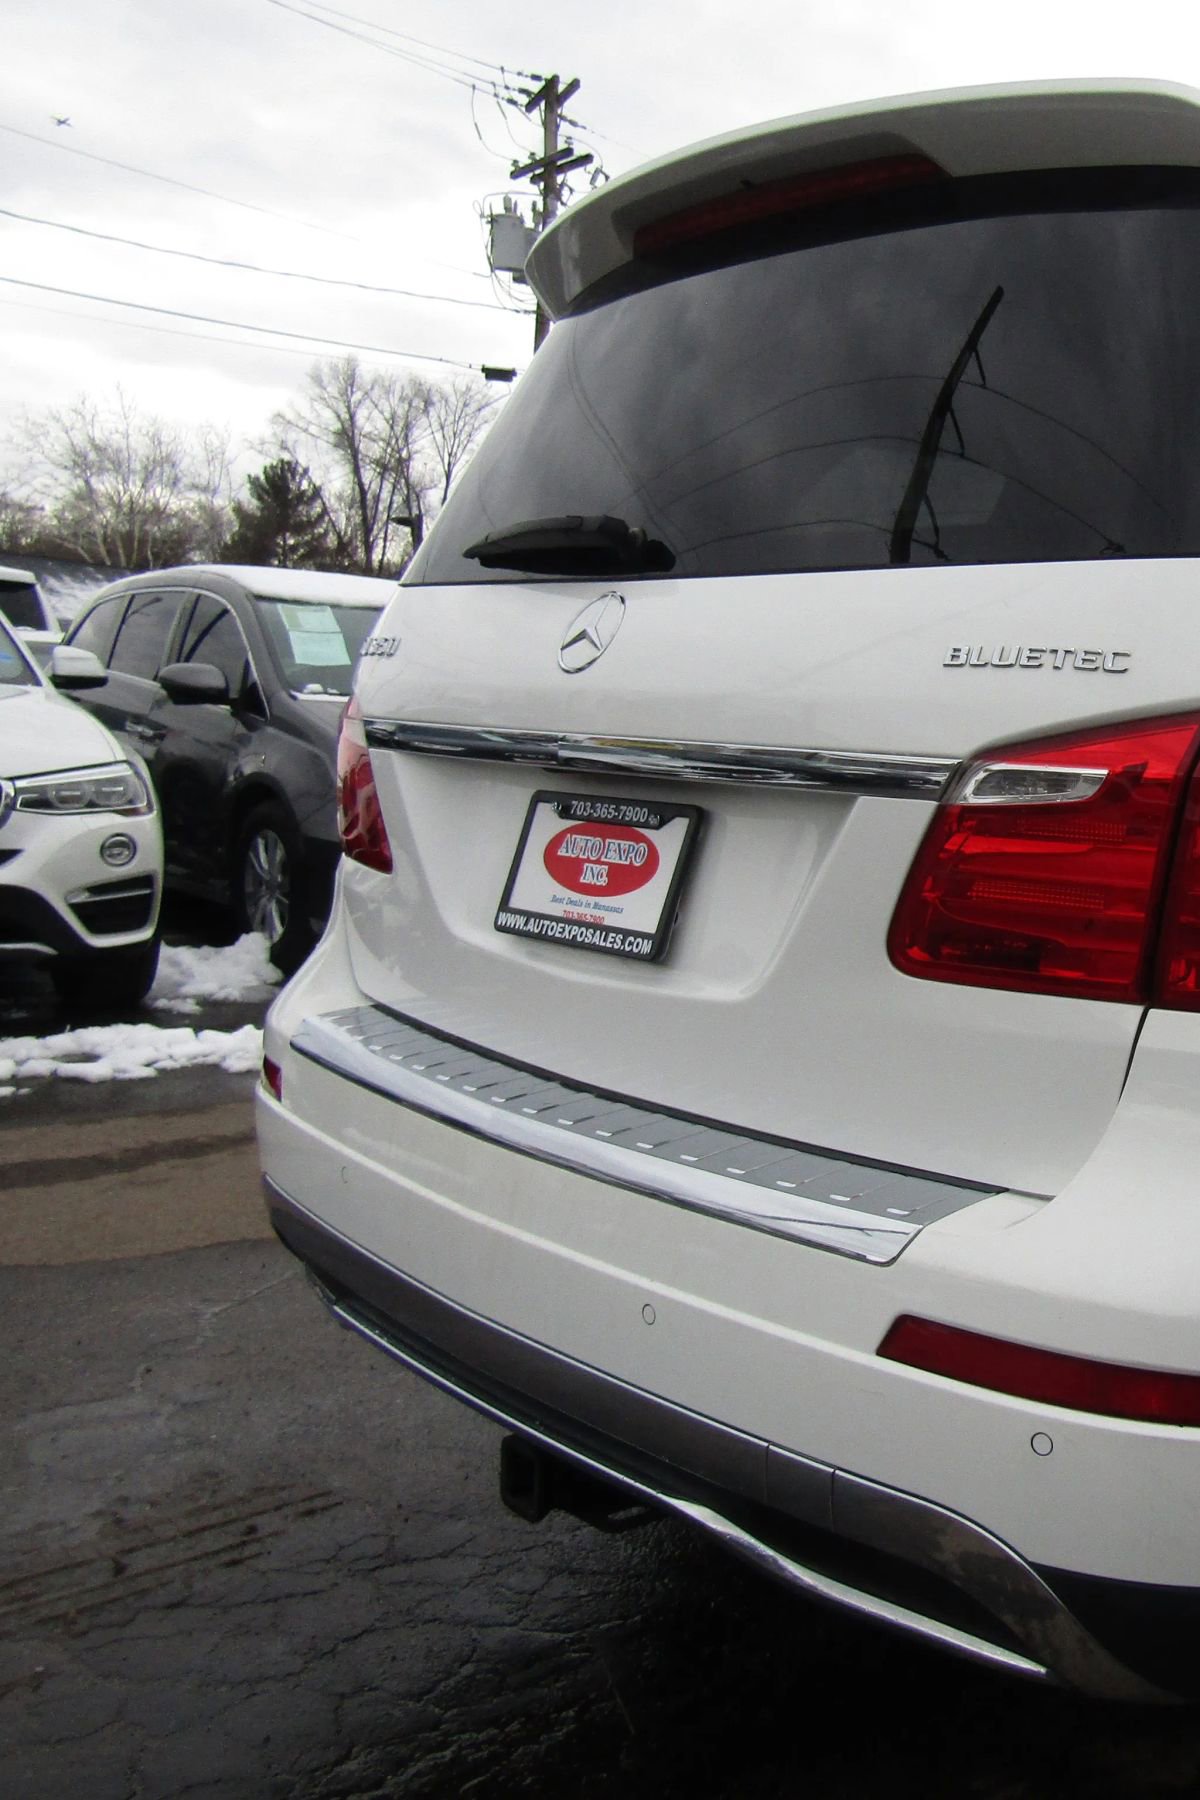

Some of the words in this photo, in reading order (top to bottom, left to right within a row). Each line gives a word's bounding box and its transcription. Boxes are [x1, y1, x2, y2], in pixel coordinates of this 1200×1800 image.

[943, 645, 1132, 673] BLUETEC
[570, 800, 648, 823] 703-365-7900
[558, 834, 602, 860] AUTO
[603, 838, 647, 867] EXPO
[580, 864, 608, 886] INC.
[551, 894, 566, 905] Best
[566, 897, 583, 908] Deals
[584, 899, 592, 909] in
[498, 912, 653, 955] WWW.AUTOEXPOSALES.COM
